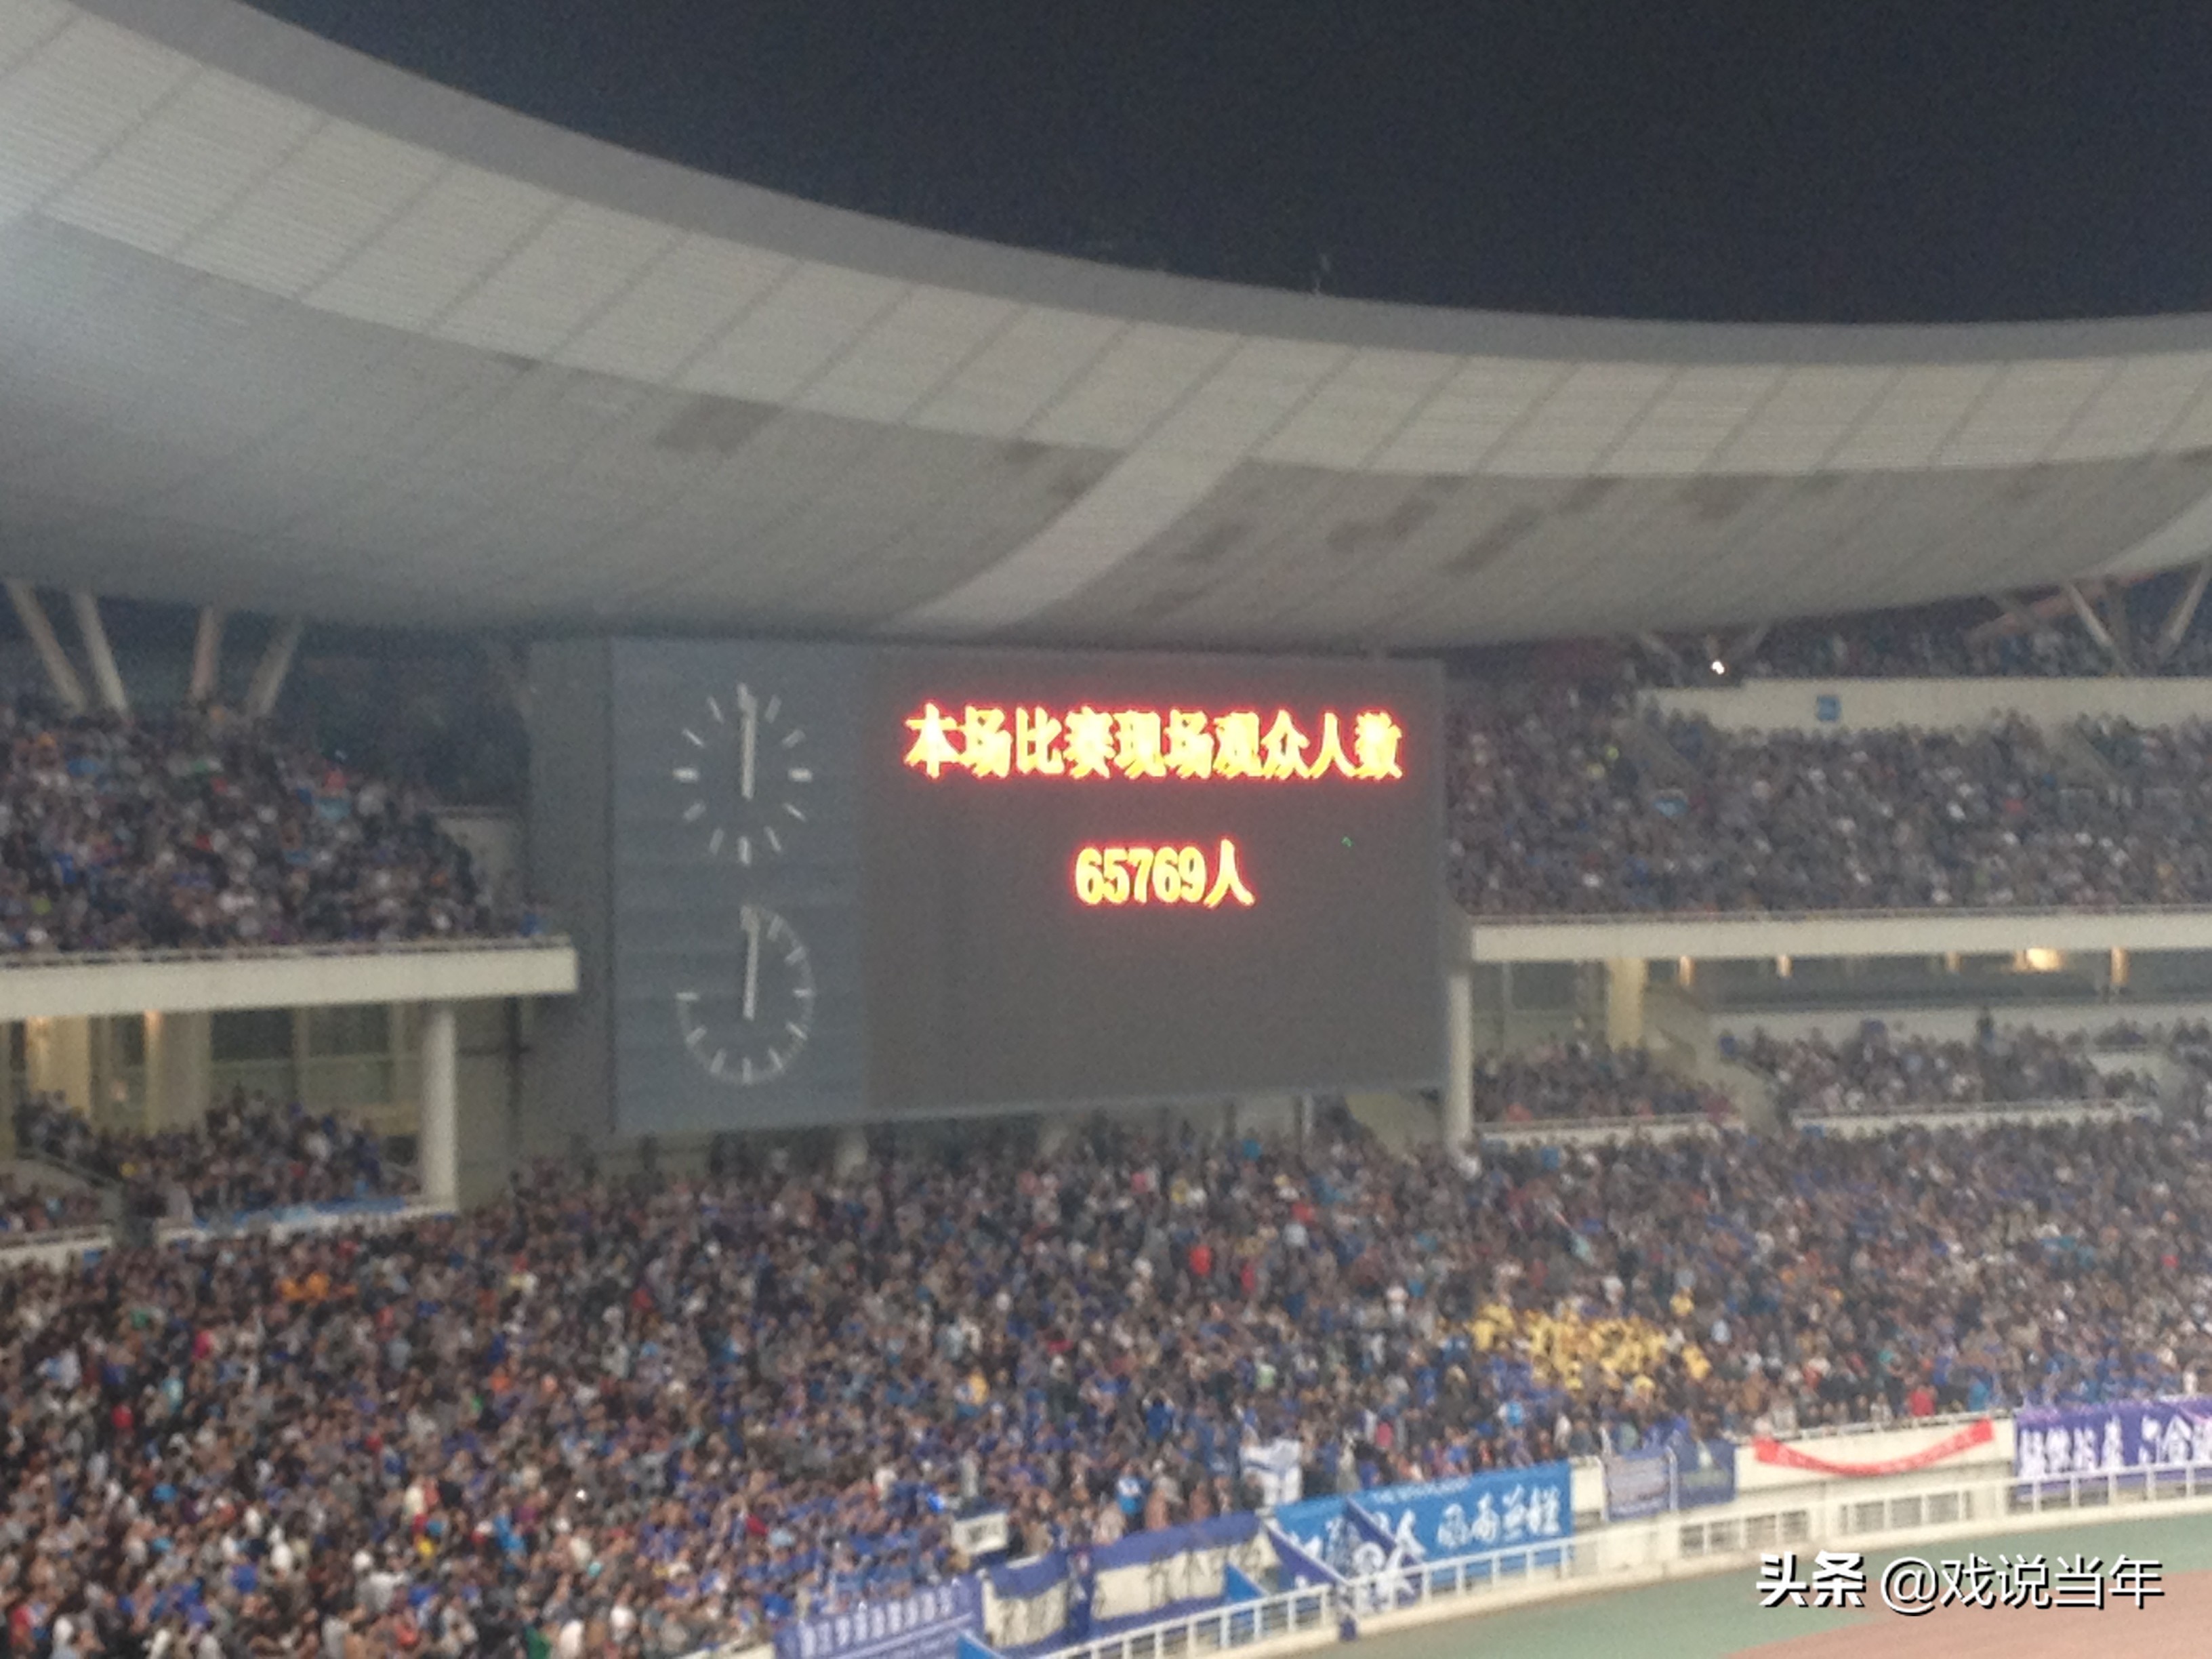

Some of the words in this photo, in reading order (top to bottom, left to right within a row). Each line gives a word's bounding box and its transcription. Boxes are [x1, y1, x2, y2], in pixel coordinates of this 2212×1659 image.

[904, 703, 1401, 779] 本场比赛现场观众人数
[1075, 837, 1255, 907] 65769人
